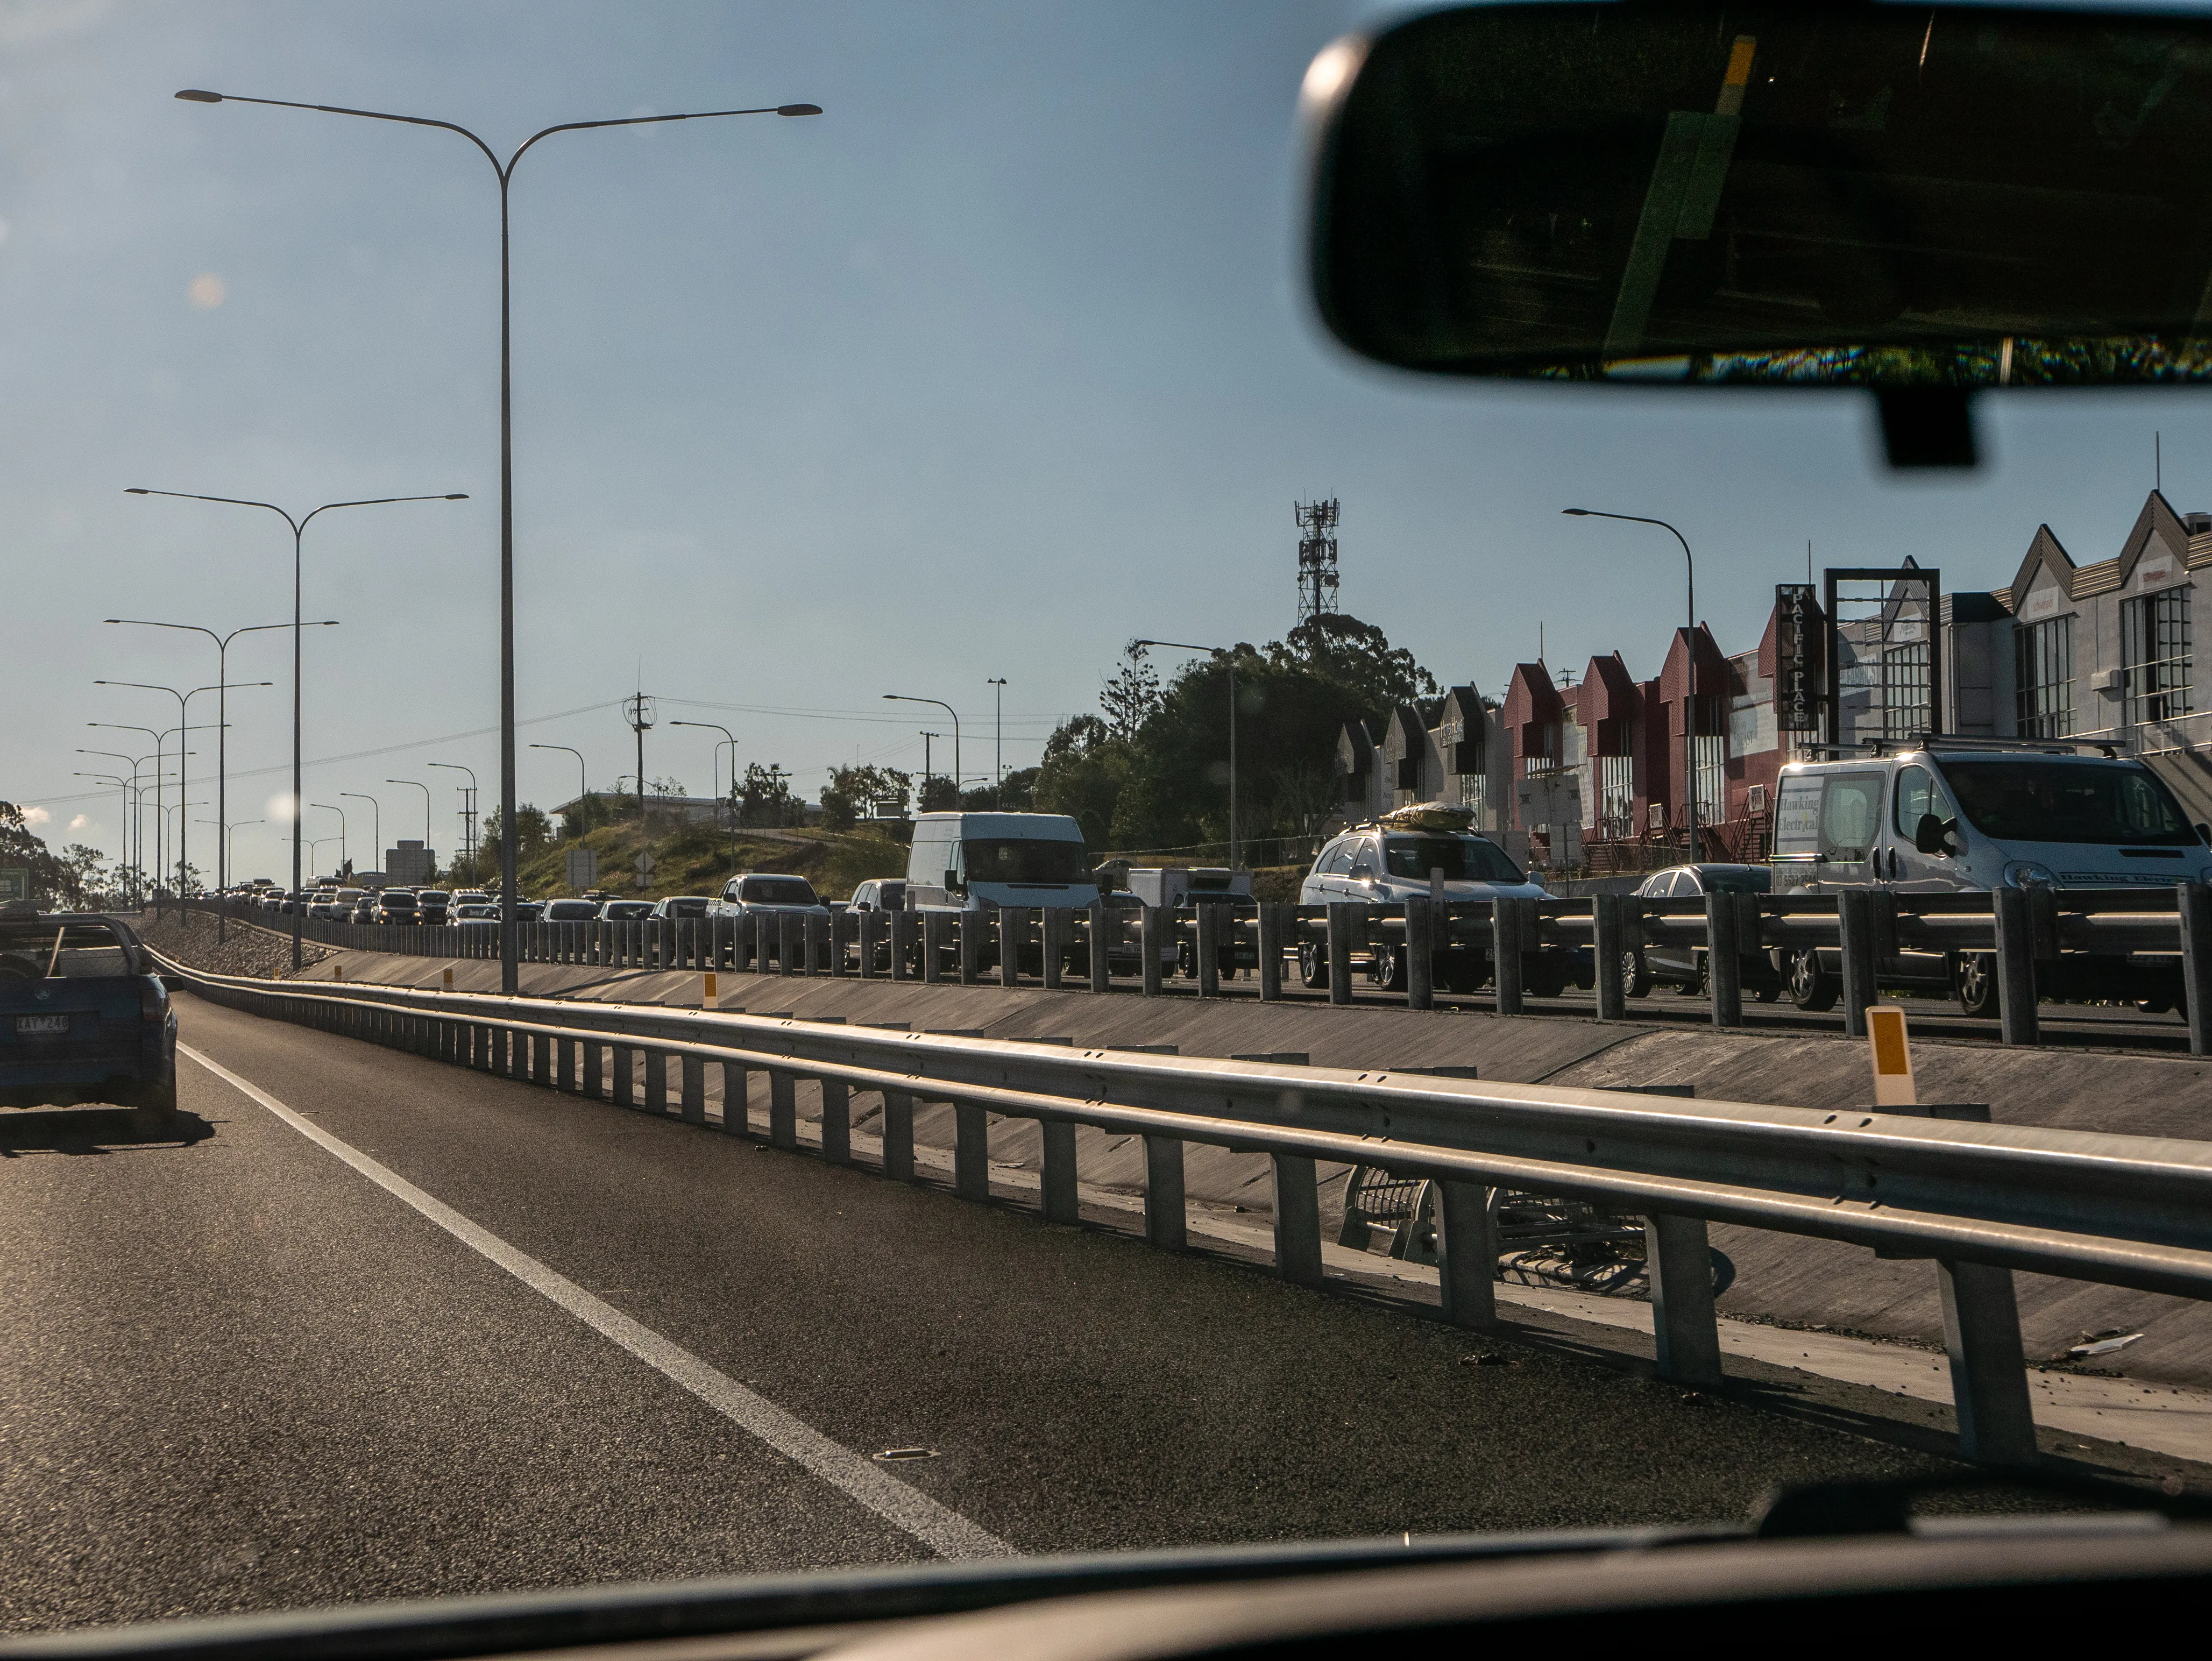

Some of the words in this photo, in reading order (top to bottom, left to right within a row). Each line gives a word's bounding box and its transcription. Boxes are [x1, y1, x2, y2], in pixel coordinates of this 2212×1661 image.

[1791, 594, 1804, 665] PACIFIC
[1793, 672, 1805, 722] PLACE
[1780, 796, 1819, 815] Hawking
[2061, 874, 2128, 883] Hawking
